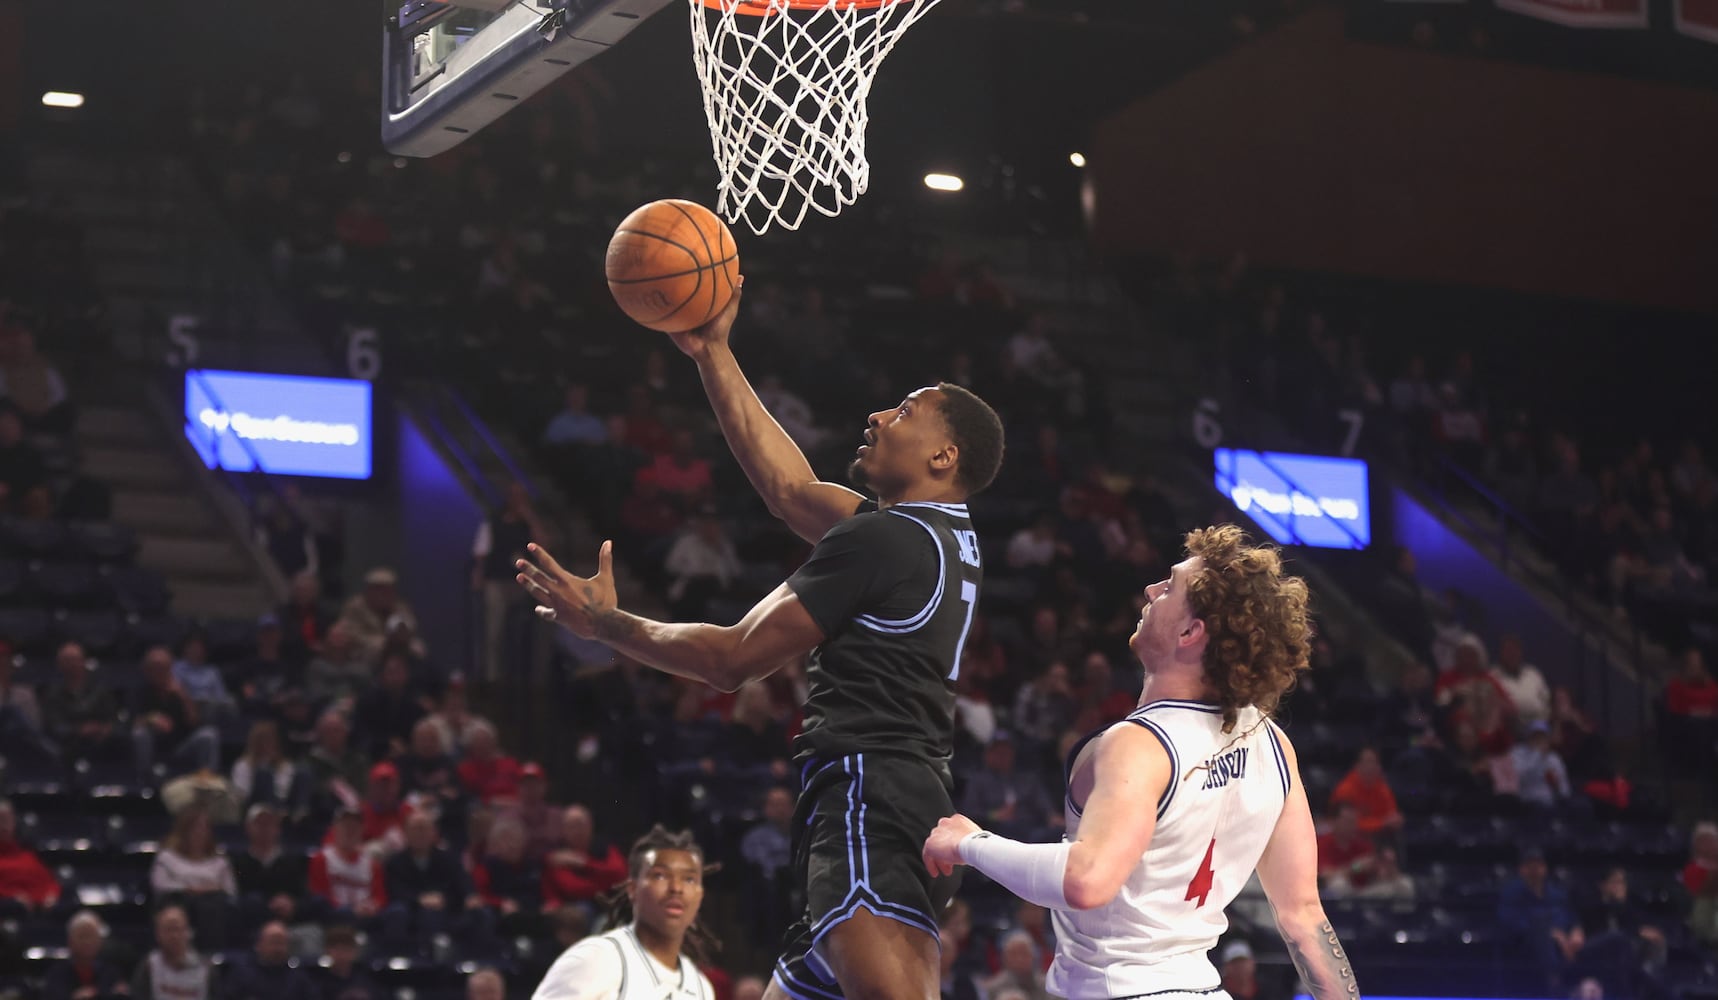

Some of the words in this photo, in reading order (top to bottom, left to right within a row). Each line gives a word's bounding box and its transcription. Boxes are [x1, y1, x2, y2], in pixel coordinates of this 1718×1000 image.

[167, 315, 199, 366] 5
[347, 327, 381, 380] 6
[1193, 397, 1222, 448] 6
[1338, 409, 1364, 457] 7
[947, 580, 977, 681] 7
[1184, 838, 1216, 909] 4
